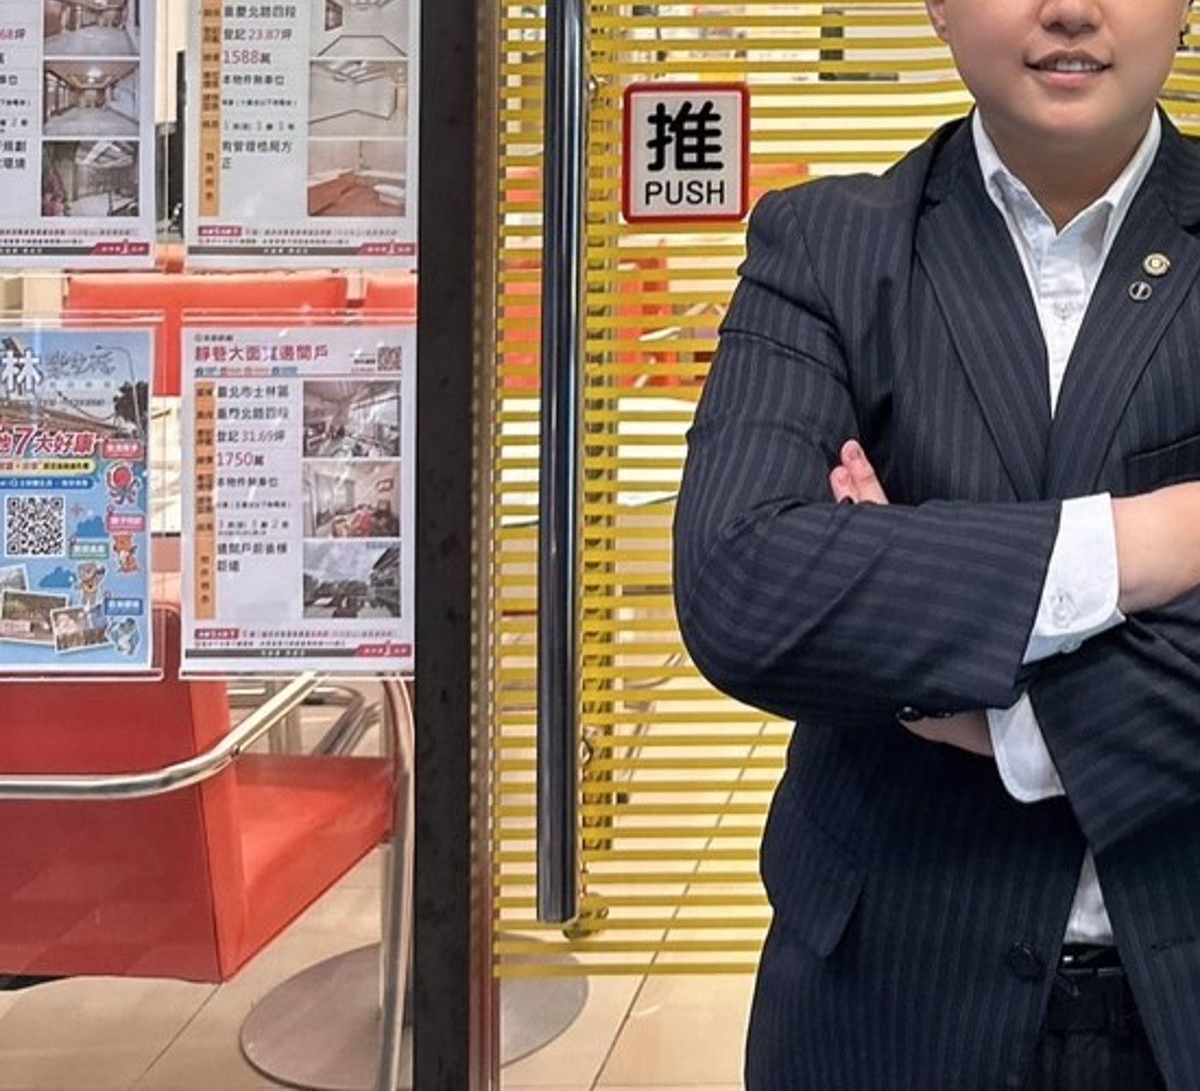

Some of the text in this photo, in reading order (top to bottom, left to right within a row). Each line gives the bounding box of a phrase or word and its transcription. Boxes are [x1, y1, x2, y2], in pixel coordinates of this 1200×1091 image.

[224, 50, 271, 64] 1588萬
[646, 100, 724, 171] 推
[645, 180, 725, 205] PUSH
[217, 452, 264, 466] 1750萬
